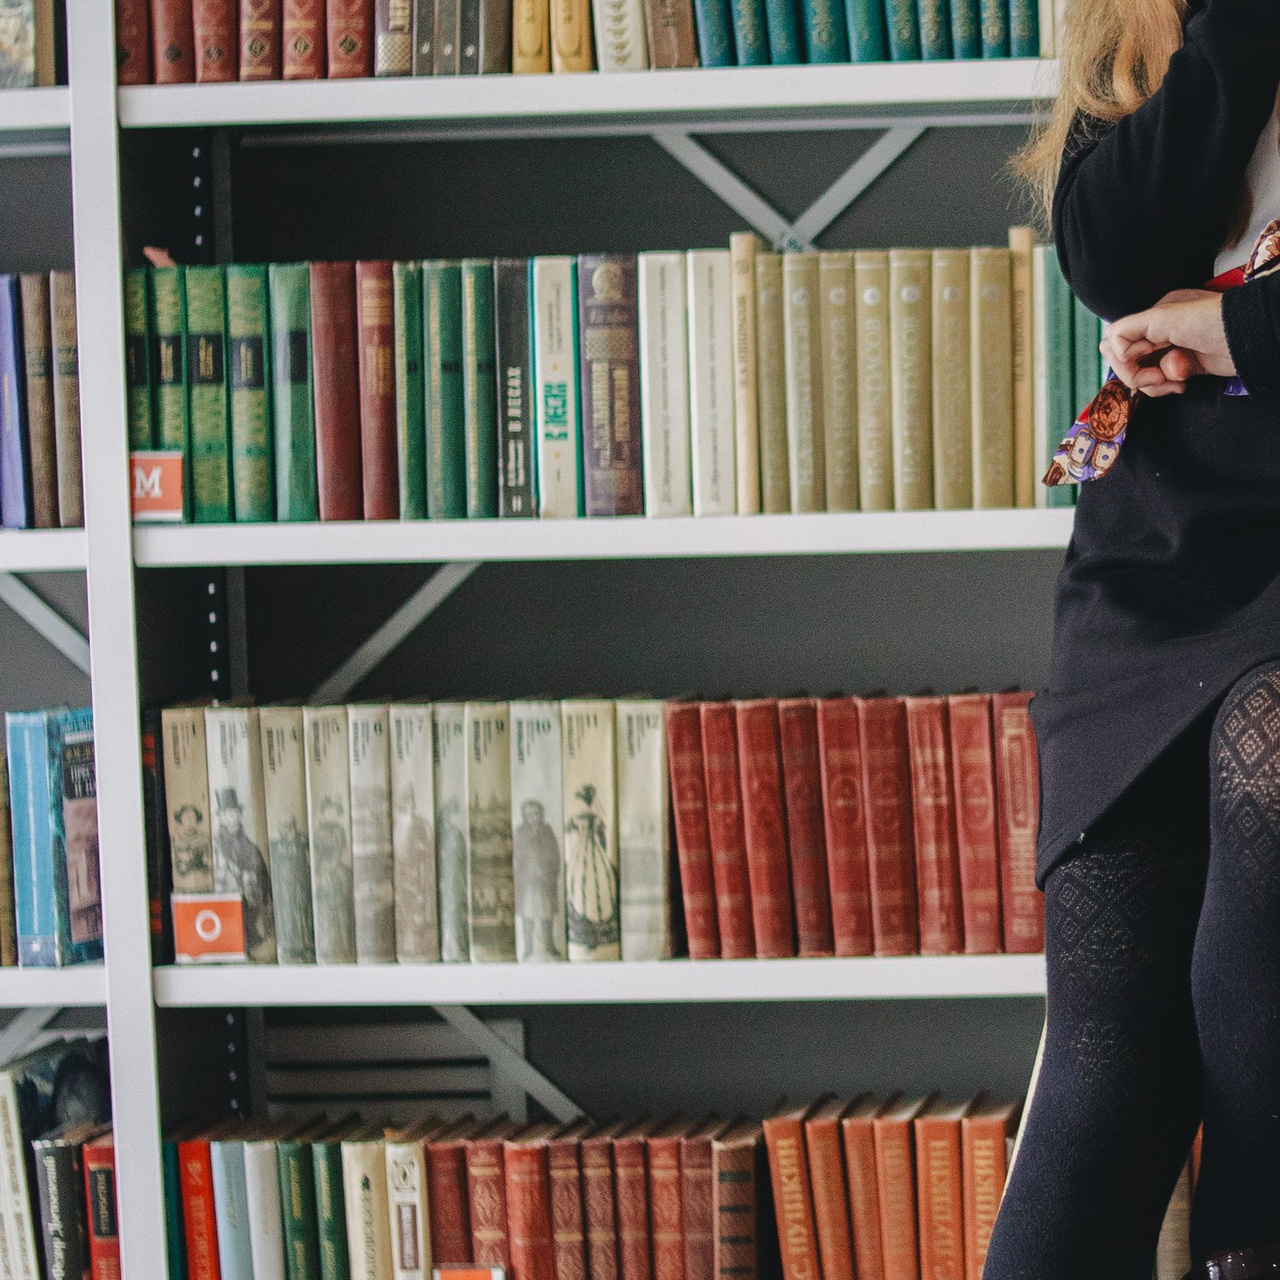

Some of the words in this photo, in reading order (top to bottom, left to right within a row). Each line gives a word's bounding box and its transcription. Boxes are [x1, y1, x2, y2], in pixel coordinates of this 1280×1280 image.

[134, 466, 163, 496] М
[194, 916, 222, 942] О
[775, 1137, 809, 1254] ПУШКИН
[928, 1139, 954, 1256] ПУШКИН
